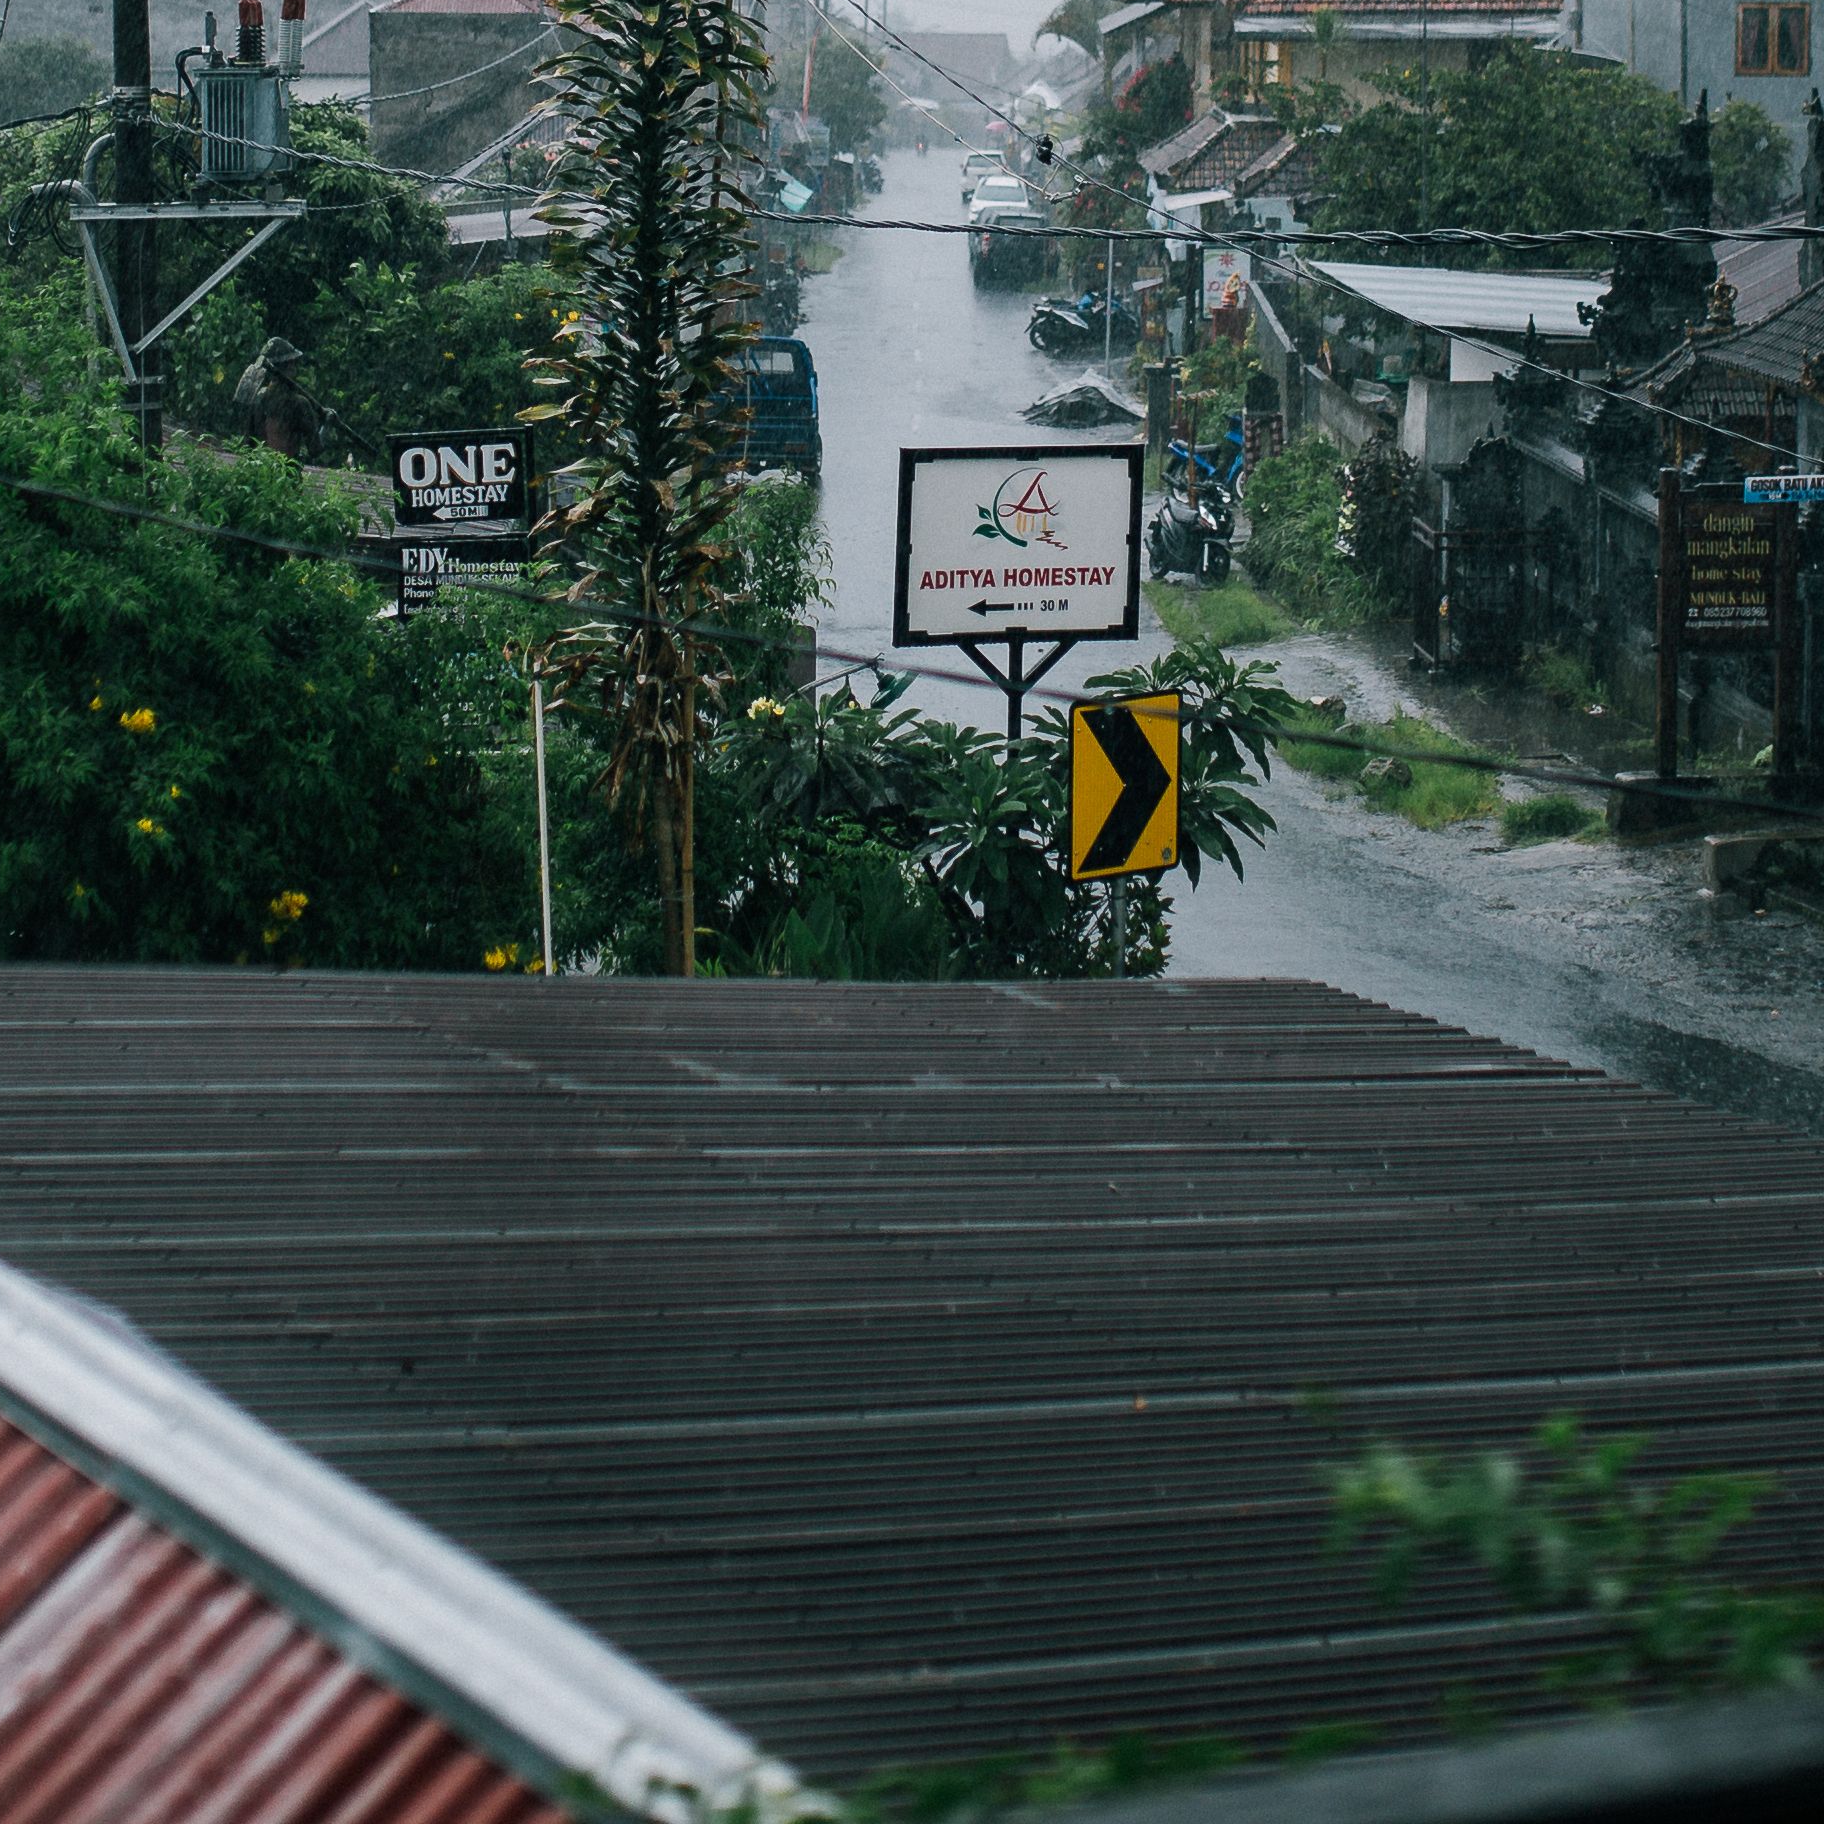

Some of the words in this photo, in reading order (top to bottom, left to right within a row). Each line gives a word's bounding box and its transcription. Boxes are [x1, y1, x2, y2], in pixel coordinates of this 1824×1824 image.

[399, 443, 516, 487] ONE
[411, 484, 509, 507] HOMESTAY
[1751, 479, 1782, 492] GOSOK
[1784, 478, 1808, 491] BATU
[1703, 513, 1755, 535] dangin
[1687, 537, 1770, 560] mangkalan
[401, 547, 449, 573] EDY
[404, 576, 433, 586] DESA
[920, 569, 996, 590] ADITYA
[1003, 567, 1115, 588] HOMESTAY
[1691, 564, 1728, 581] home
[1732, 566, 1761, 584] stay
[1040, 600, 1055, 611] 30
[1058, 599, 1069, 611] M
